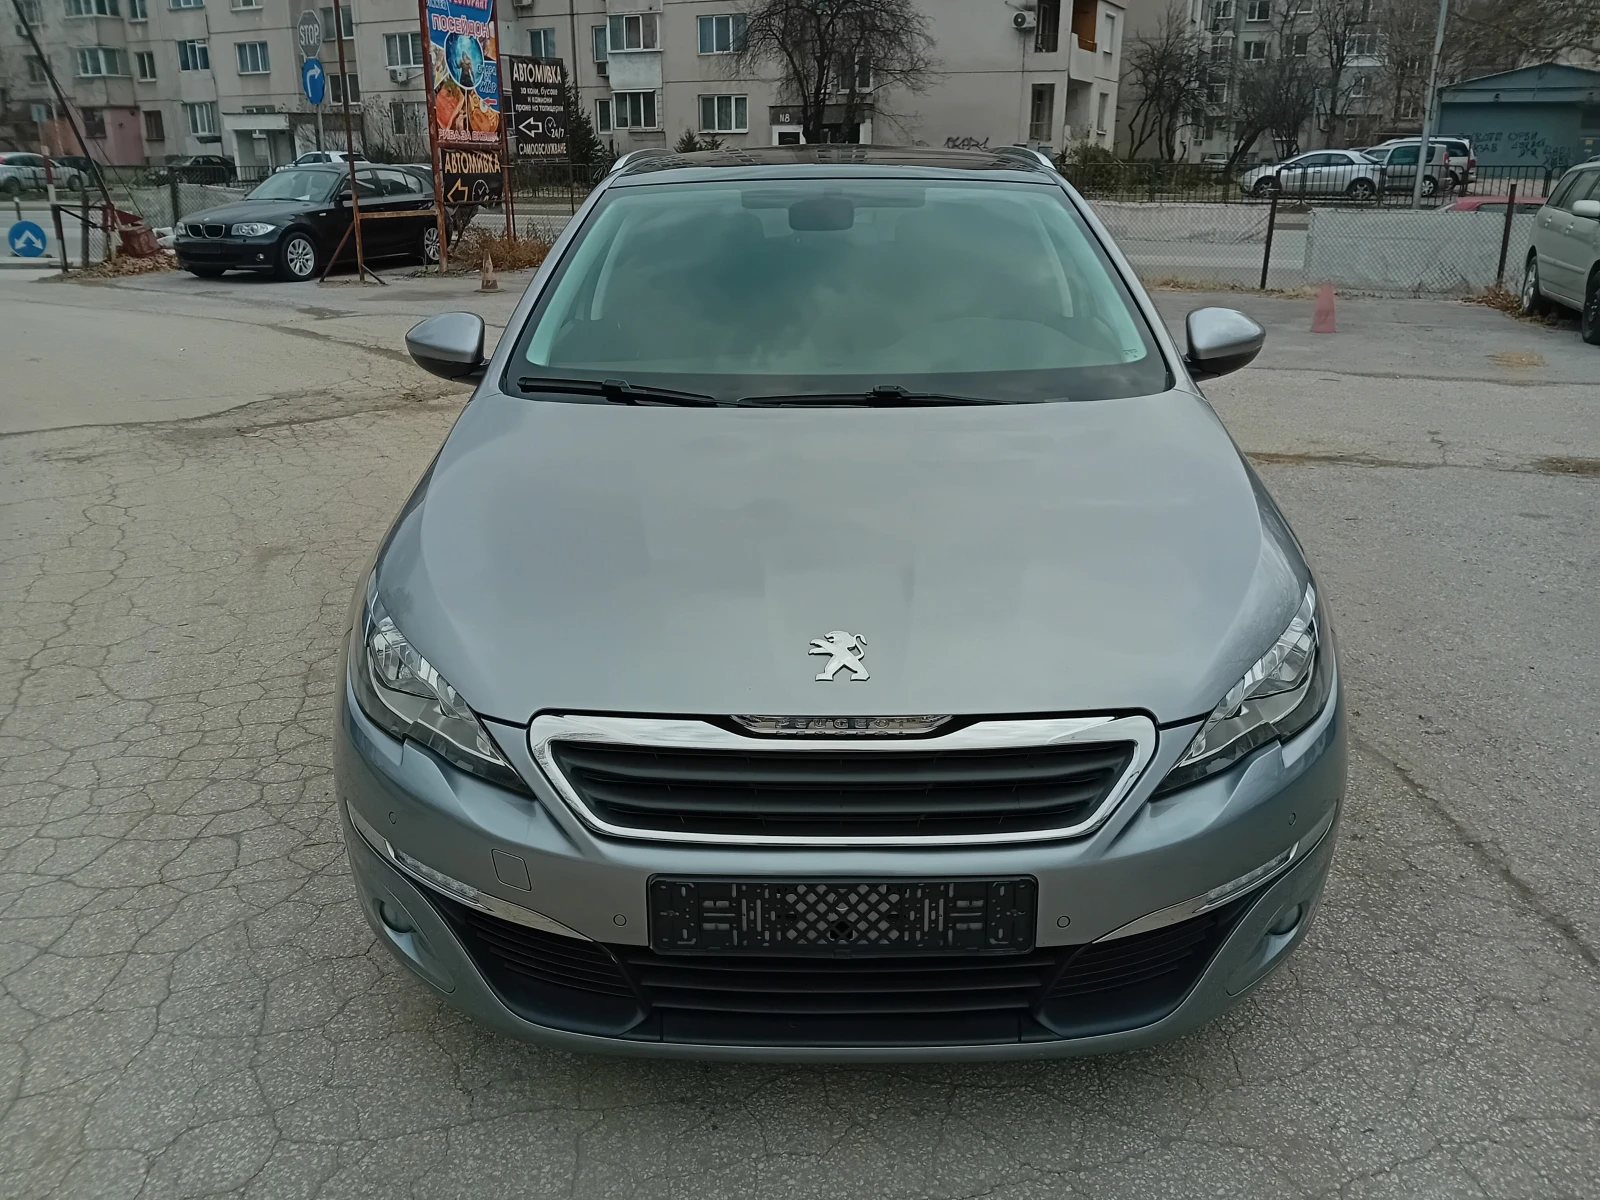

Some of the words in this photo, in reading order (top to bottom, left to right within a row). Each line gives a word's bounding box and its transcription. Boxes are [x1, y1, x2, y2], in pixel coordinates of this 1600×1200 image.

[299, 24, 320, 46] STOP
[432, 13, 489, 38] ПОСЕЙДОН
[513, 62, 562, 83] АВТОМИВКА
[438, 128, 460, 140] РИБА
[551, 128, 564, 139] 24/7
[518, 142, 567, 155] САМООБСЛУЖВАНЕ
[444, 152, 501, 174] АВТОМИВКА
